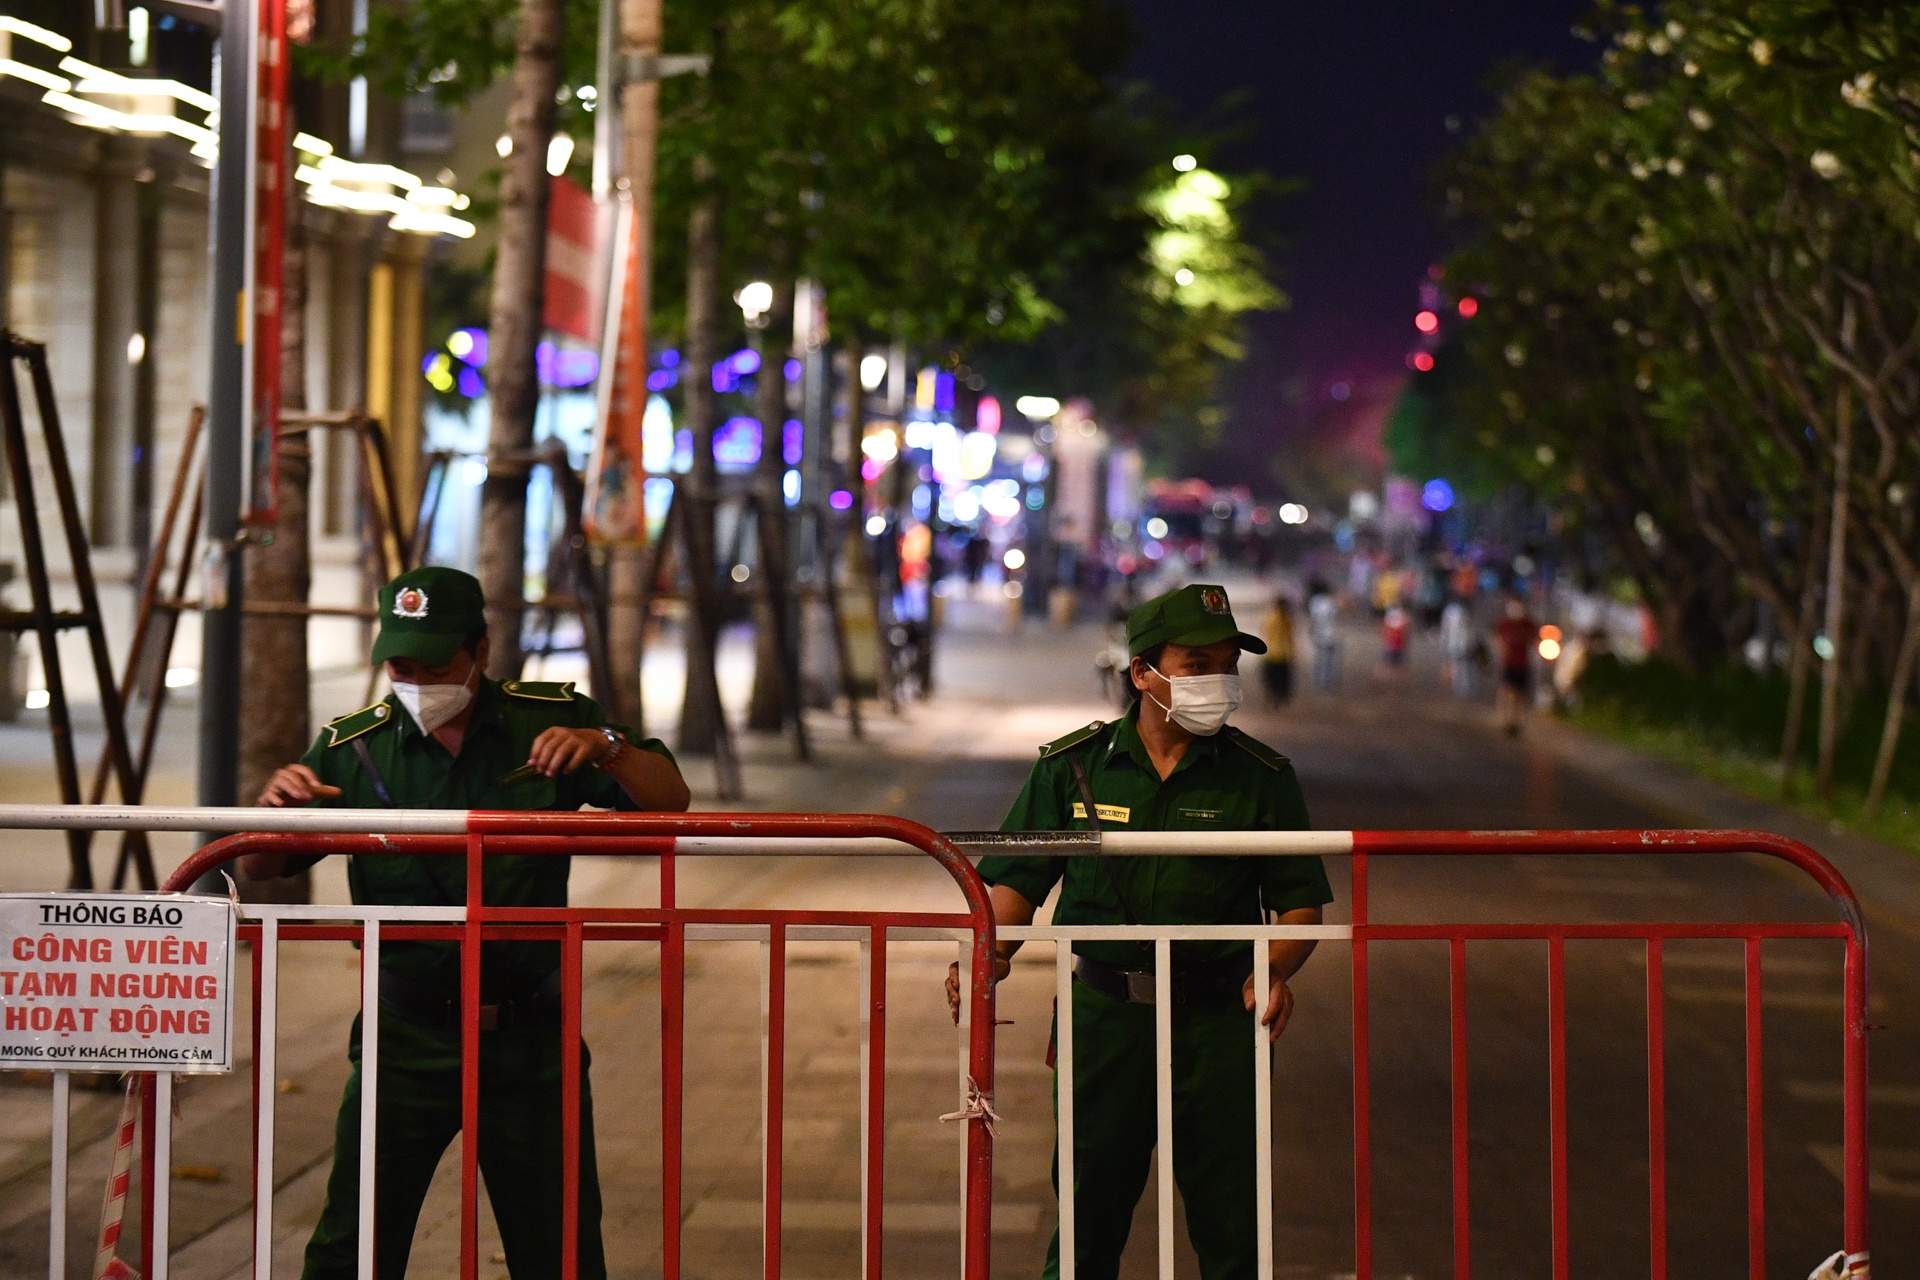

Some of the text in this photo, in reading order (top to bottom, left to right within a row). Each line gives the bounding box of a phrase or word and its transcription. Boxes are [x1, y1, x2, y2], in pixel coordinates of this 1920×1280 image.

[40, 903, 183, 925] THÔNG BÁO
[13, 932, 207, 965] CÔNG VIÊN
[0, 971, 217, 1001] TẠM NGƯNG
[5, 1004, 210, 1038] HOẠT ĐỘNG
[1, 1045, 212, 1060] MONG QUÝ KHÁCH THÔNG CẢM
